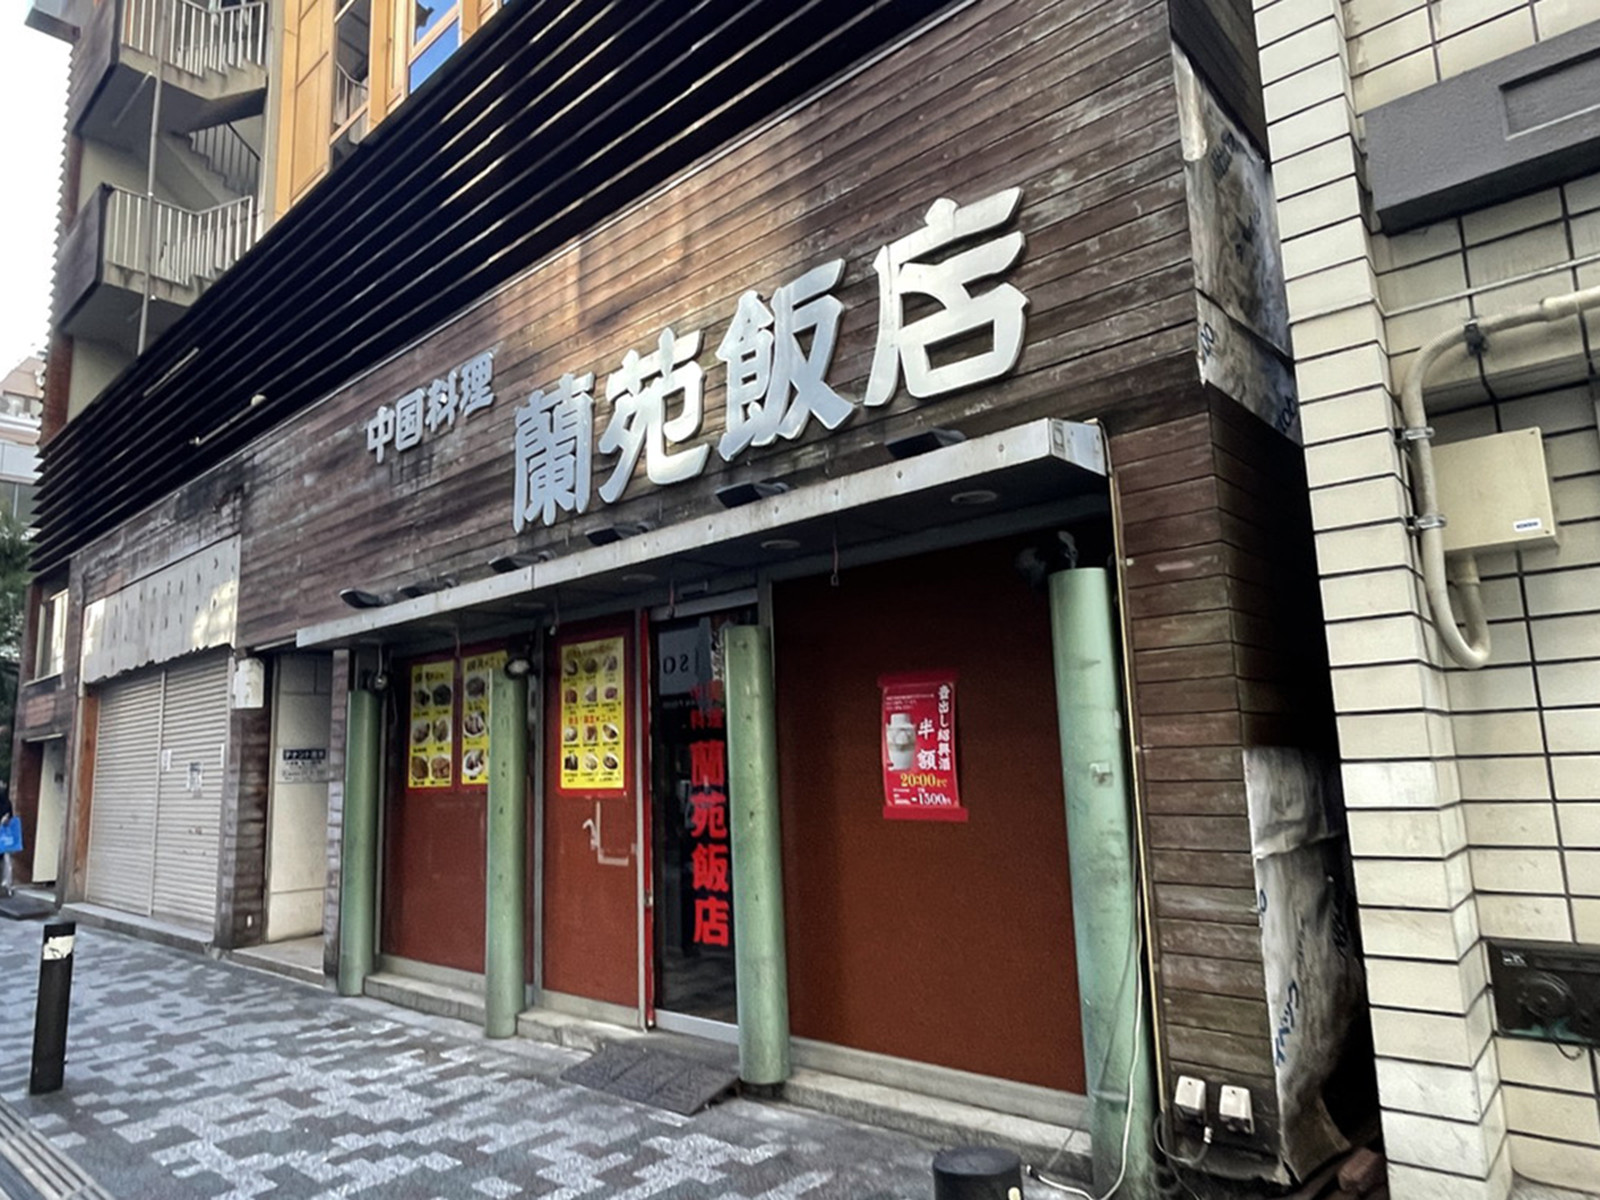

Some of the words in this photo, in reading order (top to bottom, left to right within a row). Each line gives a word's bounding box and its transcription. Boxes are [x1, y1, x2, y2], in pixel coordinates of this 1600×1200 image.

[366, 351, 495, 463] 中国料理
[512, 186, 1030, 534] 蘭苑飯店
[690, 740, 730, 947] 蘭苑飯店
